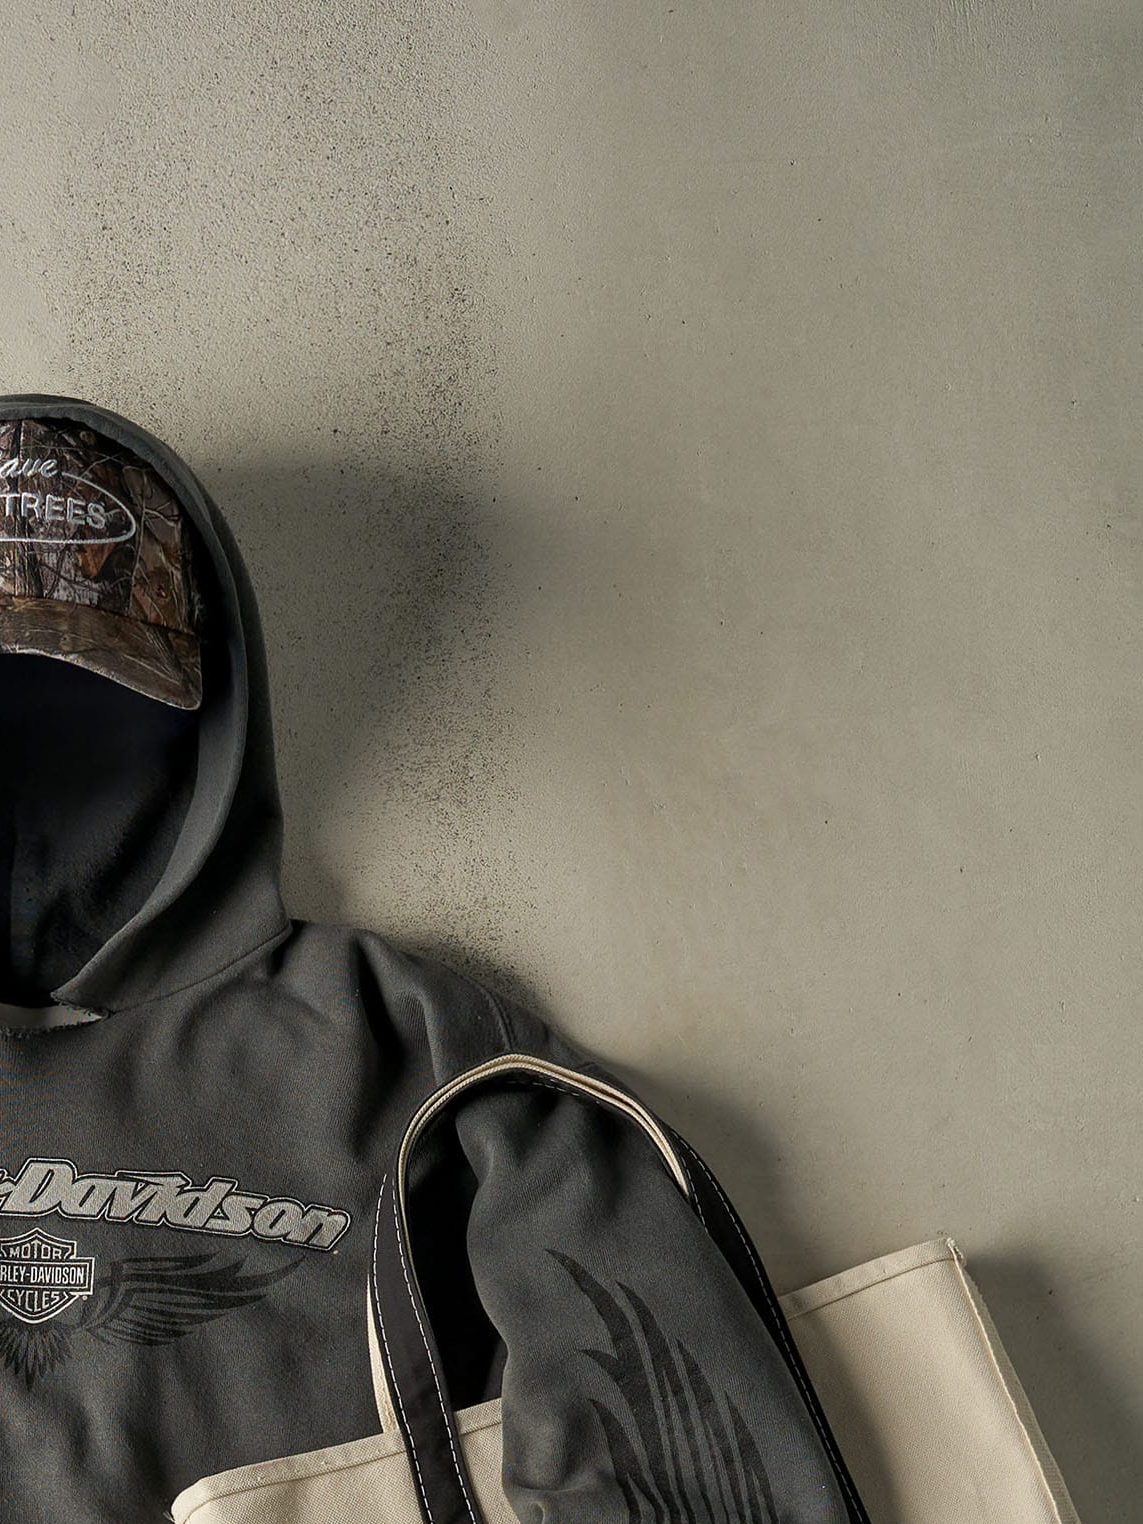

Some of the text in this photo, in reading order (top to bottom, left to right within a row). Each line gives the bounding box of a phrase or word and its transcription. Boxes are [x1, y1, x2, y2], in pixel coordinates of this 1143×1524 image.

[0, 491, 107, 529] TREES
[8, 1239, 63, 1260] MOTOR
[6, 1288, 61, 1313] CYCLES
